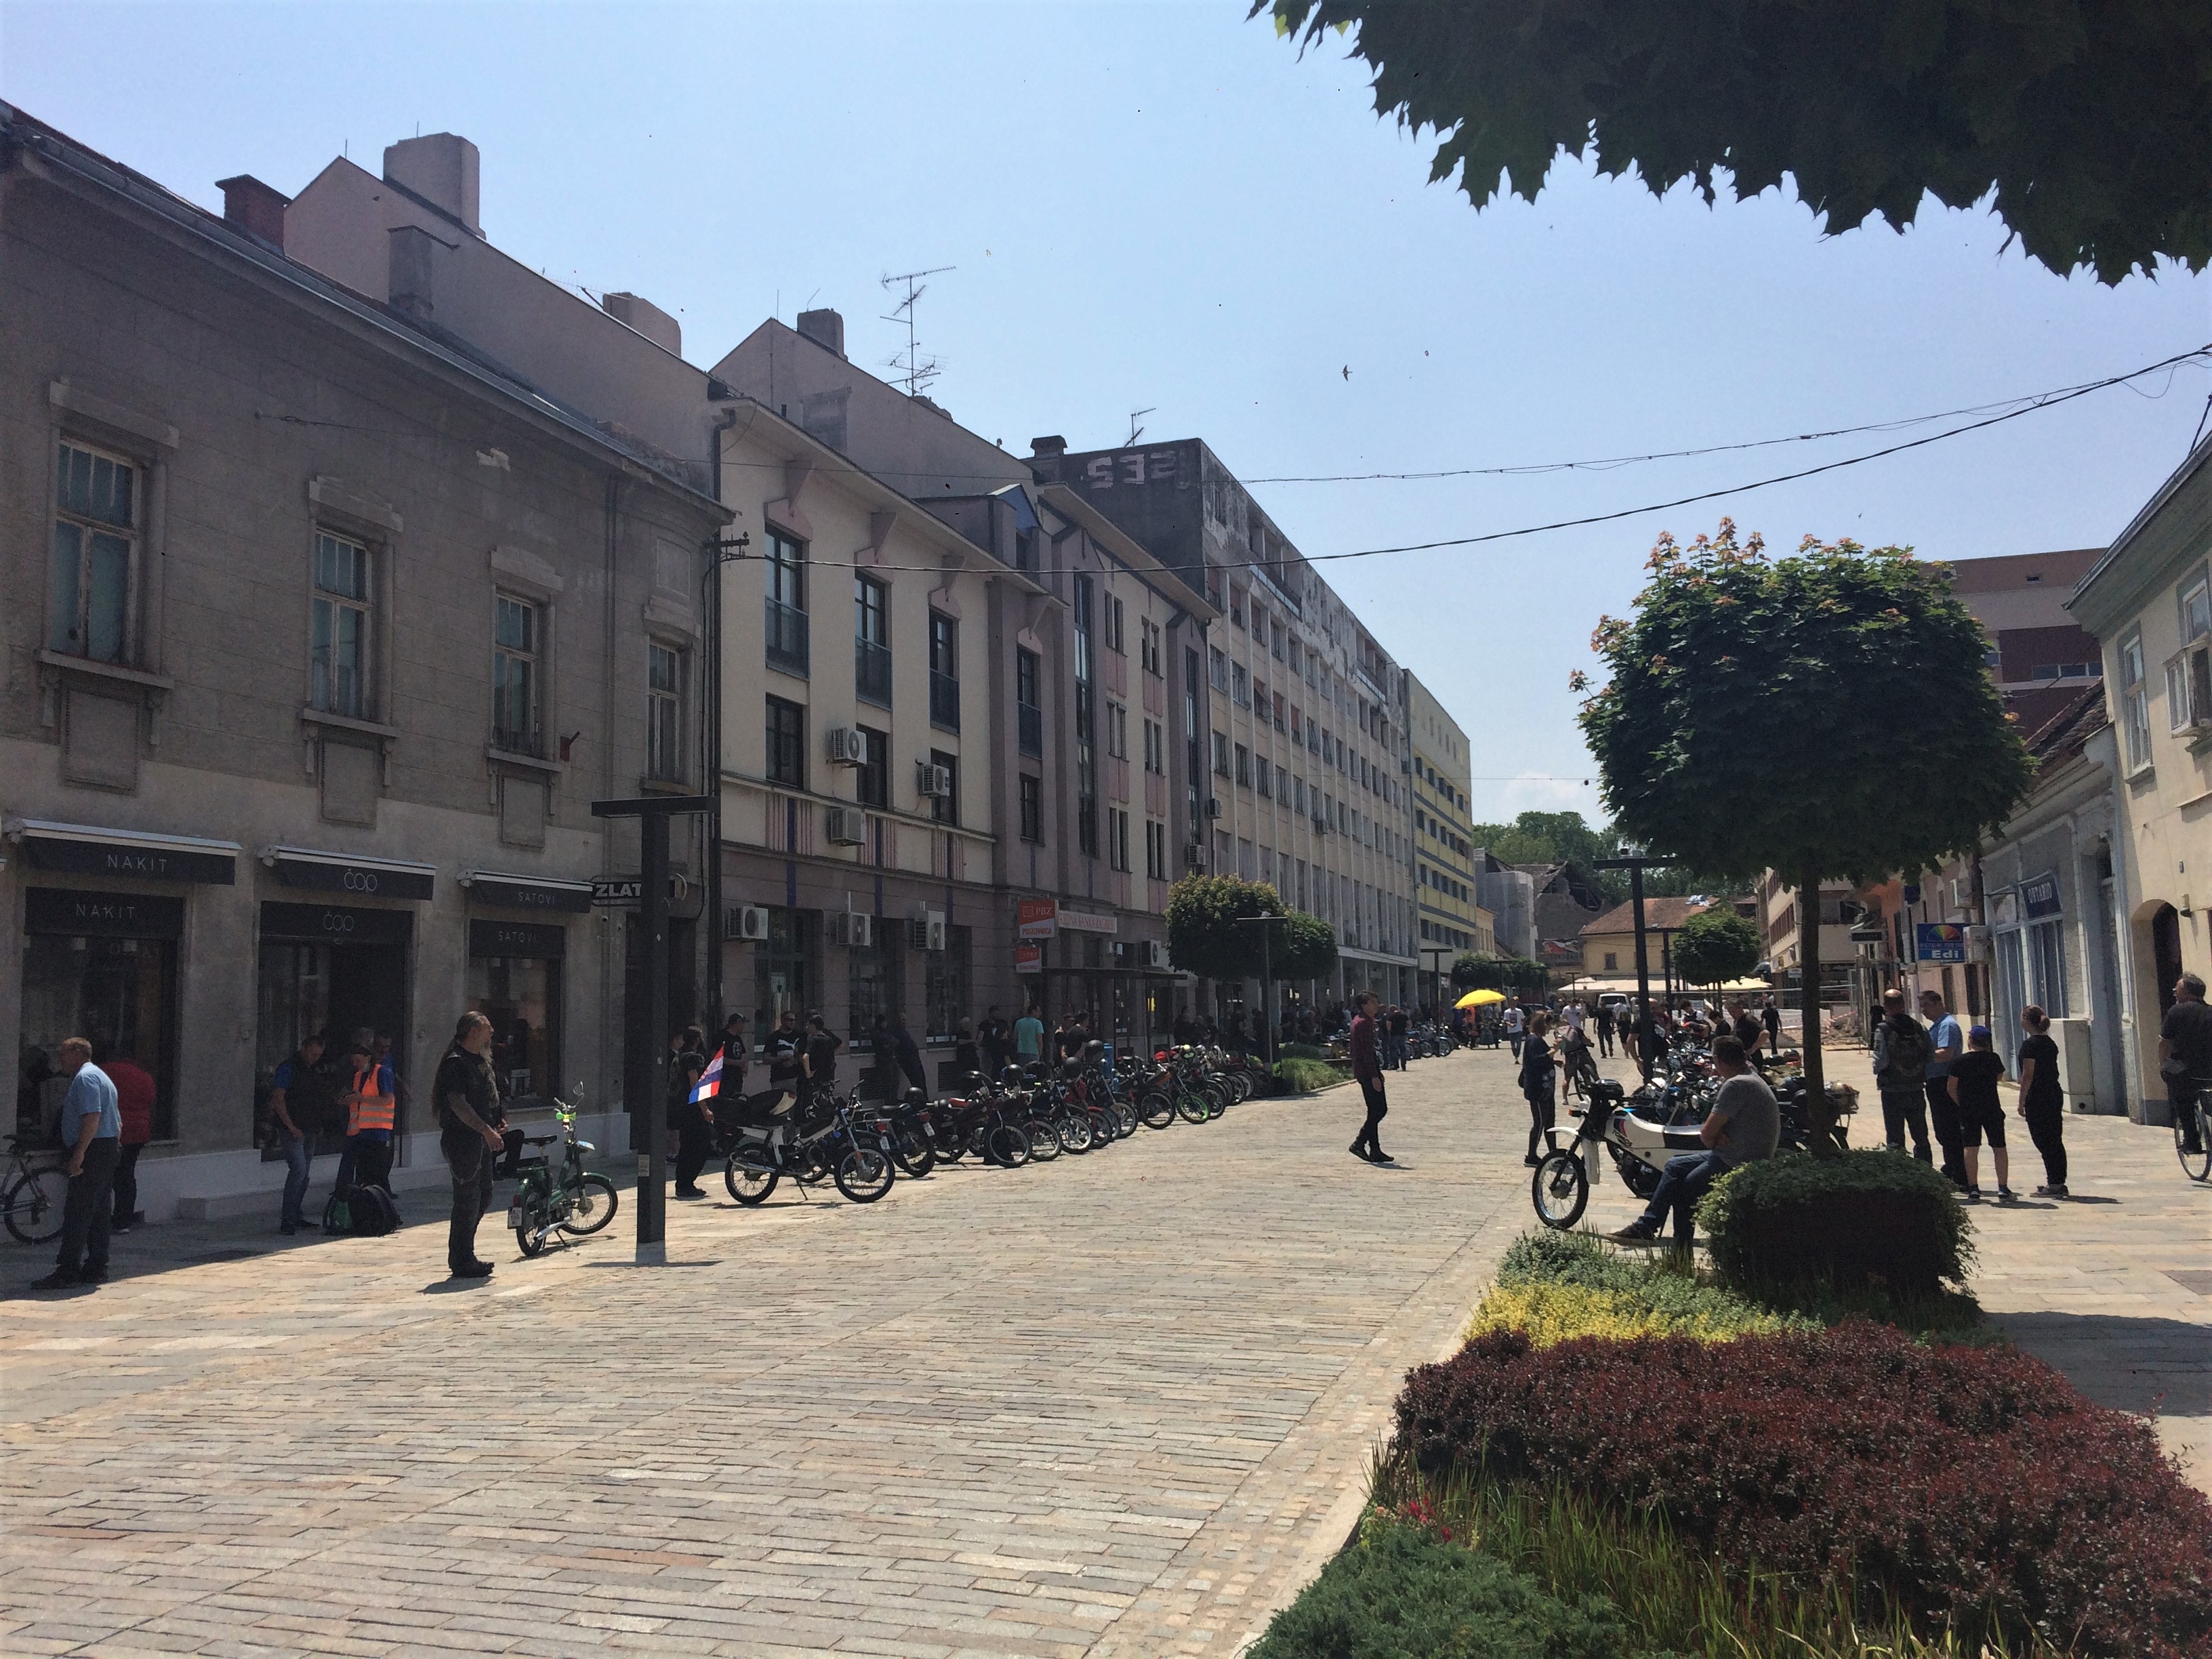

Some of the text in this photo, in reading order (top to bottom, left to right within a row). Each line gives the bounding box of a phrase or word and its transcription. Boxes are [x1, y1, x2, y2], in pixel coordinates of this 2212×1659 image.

[107, 855, 167, 872] NAKIT
[518, 891, 555, 905] SATOVI
[2027, 882, 2052, 903] ONTARIO
[76, 903, 135, 919] NAKIT
[1036, 907, 1052, 916] PBZ
[498, 930, 536, 943] SATOVI
[1022, 927, 1052, 935] POSLOVNICA
[1931, 949, 1959, 959] Edi
